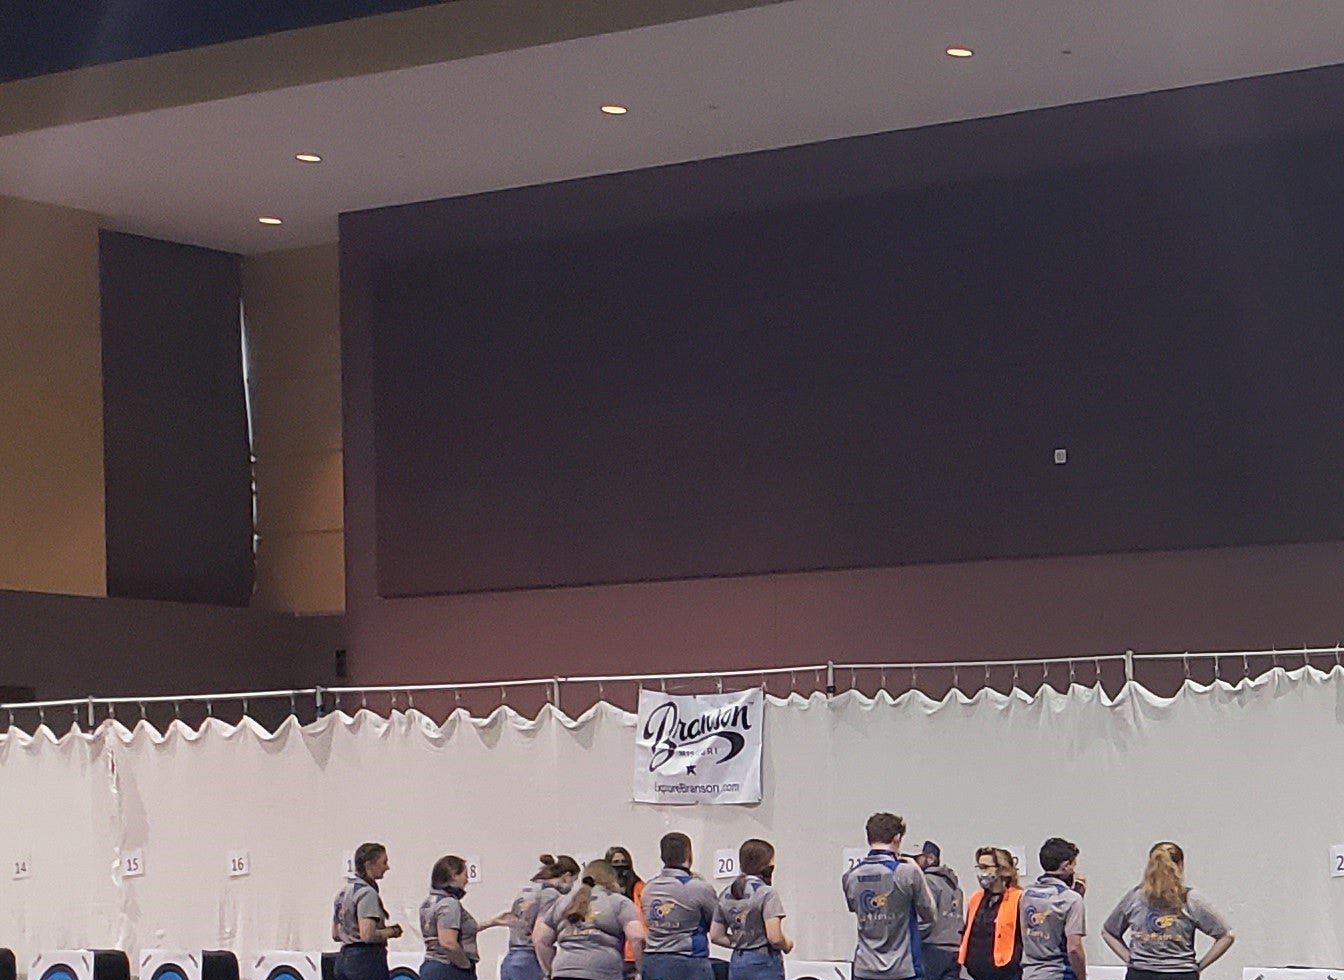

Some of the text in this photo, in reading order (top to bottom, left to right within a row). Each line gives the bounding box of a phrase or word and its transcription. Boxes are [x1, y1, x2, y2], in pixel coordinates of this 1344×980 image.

[643, 701, 752, 772] Branson
[14, 861, 27, 874] 14
[126, 858, 139, 871] 15
[231, 857, 244, 871] 16
[718, 858, 734, 873] 20
